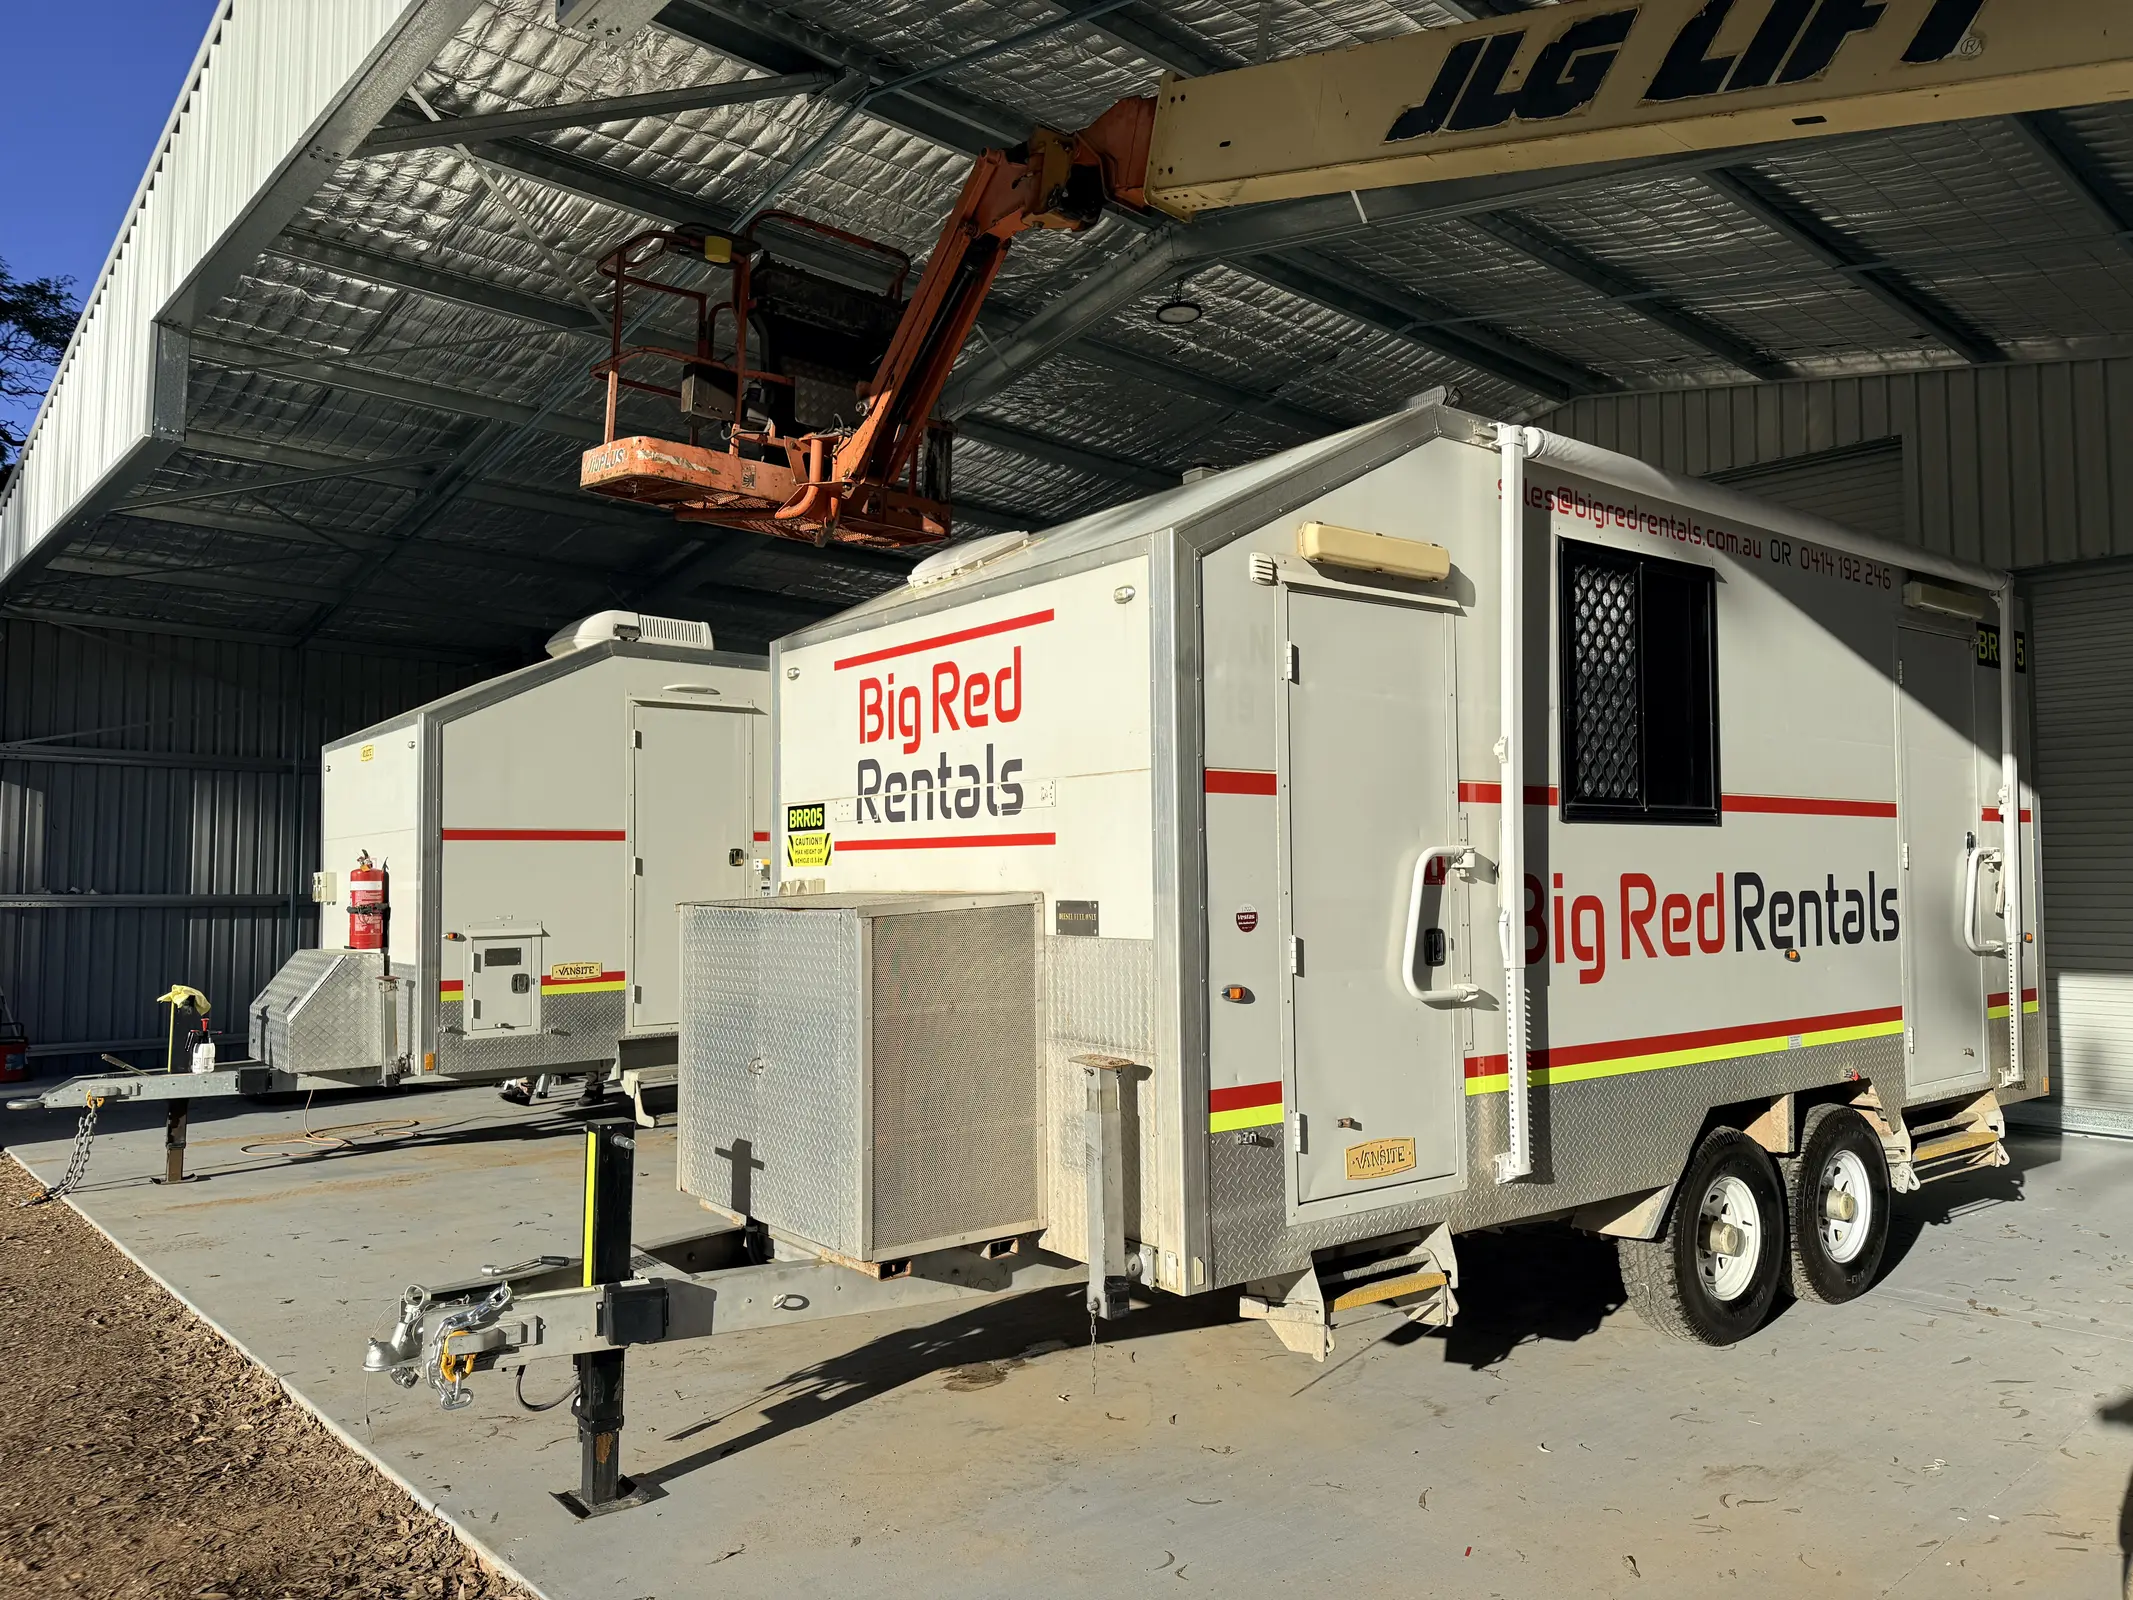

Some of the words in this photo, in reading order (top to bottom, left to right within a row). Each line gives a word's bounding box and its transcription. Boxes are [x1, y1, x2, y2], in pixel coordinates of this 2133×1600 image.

[1384, 7, 1641, 142] JLG
[1498, 478, 1761, 559] les@bigredrentals.com.au
[1770, 539, 1791, 566] OR
[1800, 547, 1834, 576] 0414
[1838, 557, 1861, 582] 192
[1865, 563, 1892, 590] 246
[1978, 630, 2025, 666] BR5
[859, 672, 921, 755] Big
[932, 645, 1022, 734] Red
[789, 807, 823, 829] BRR05
[856, 743, 1024, 824] Rentals
[1524, 872, 1605, 984] Big
[558, 965, 595, 976] VANSITE
[1355, 1145, 1405, 1169] VANSITE
